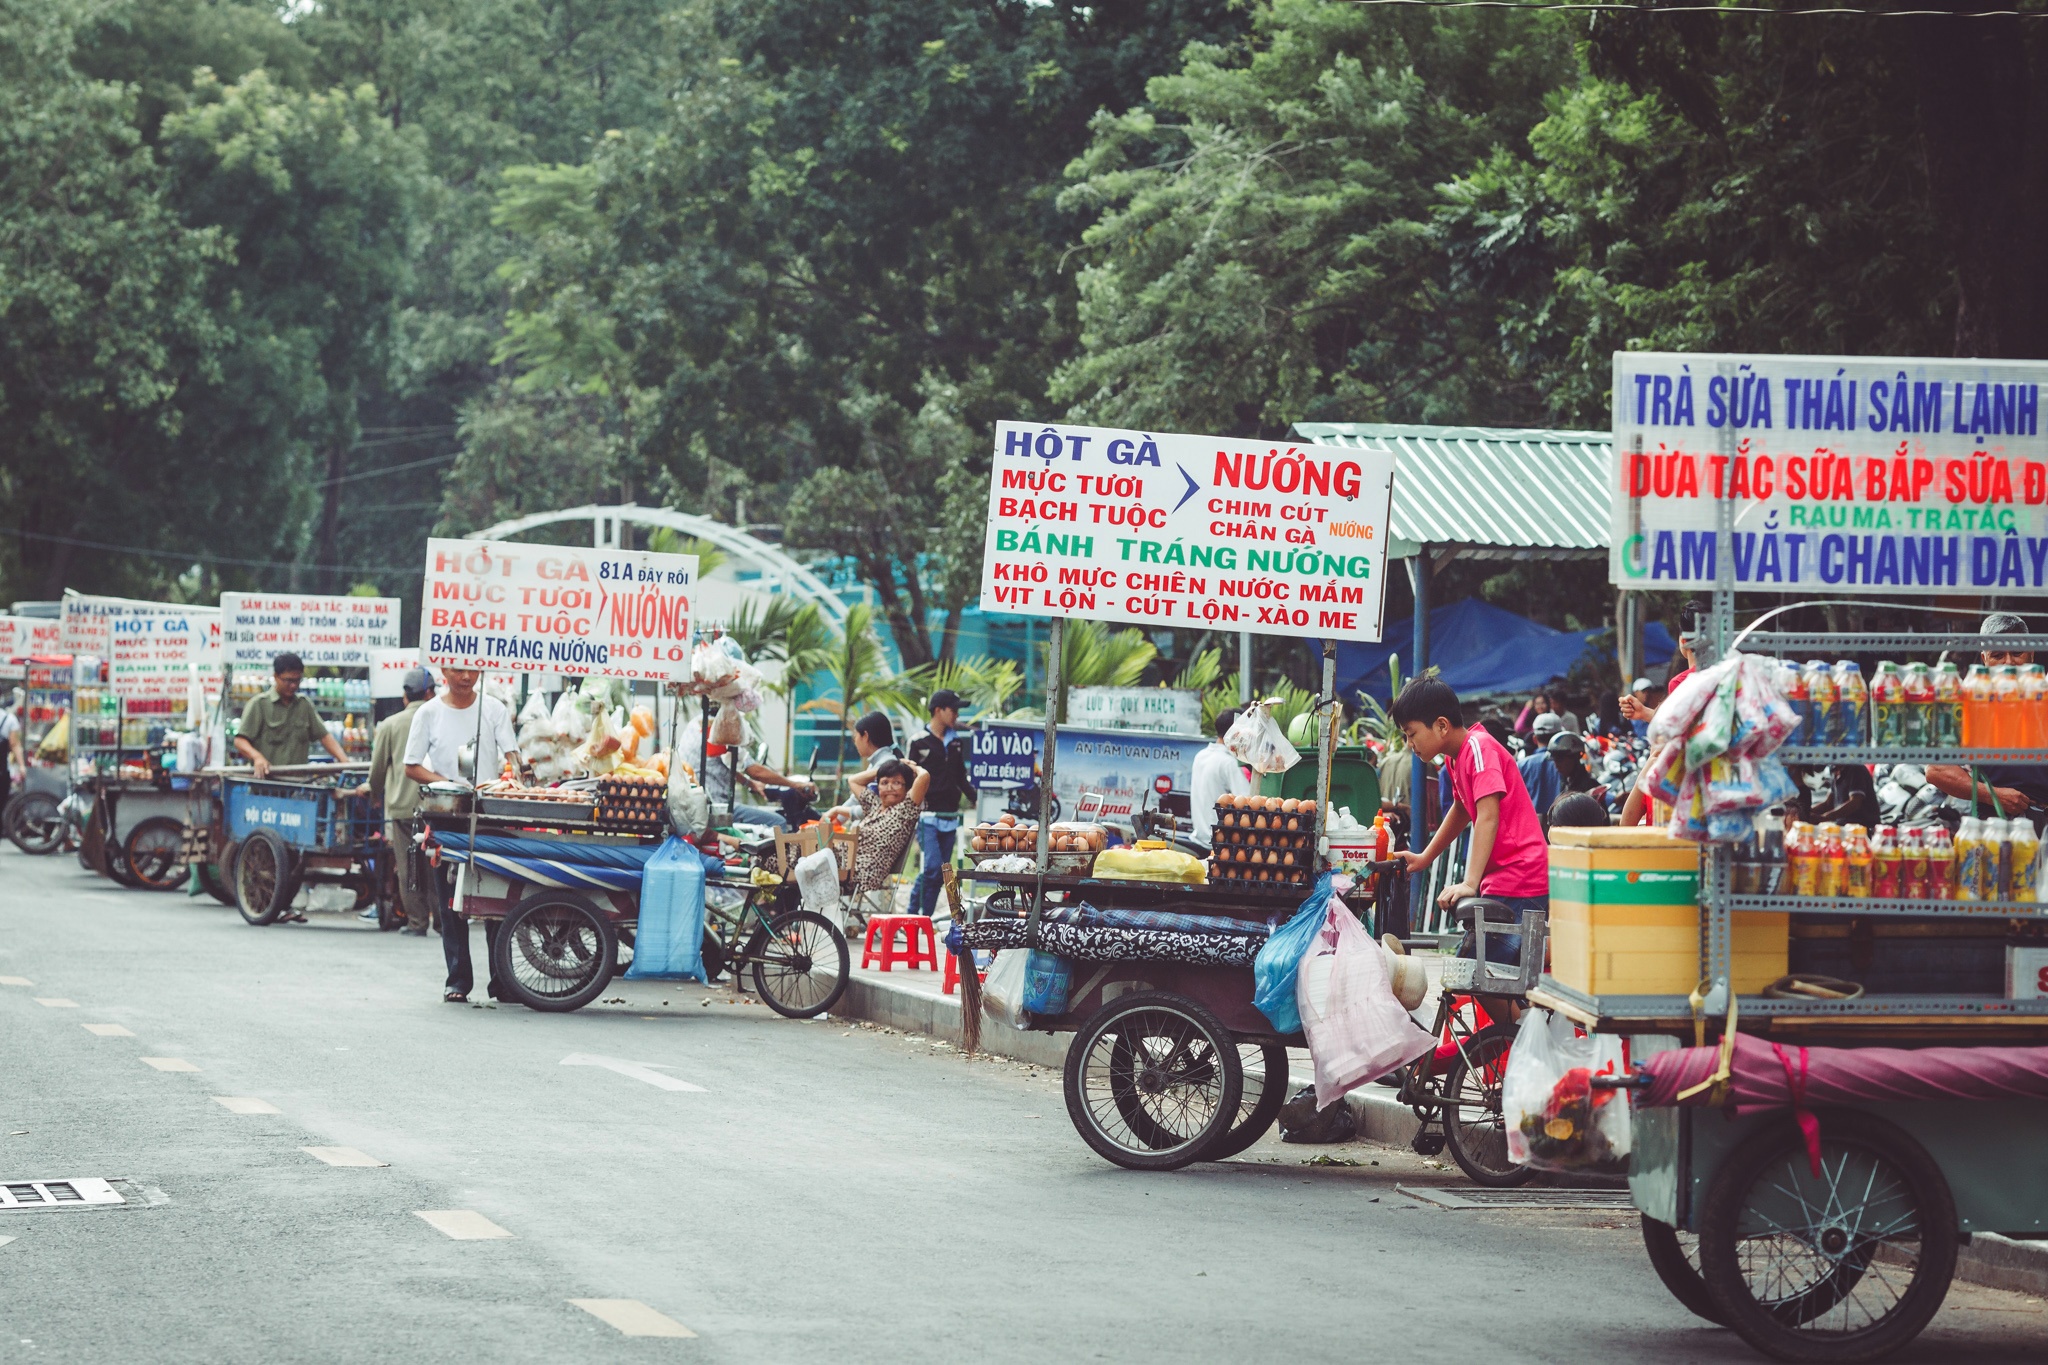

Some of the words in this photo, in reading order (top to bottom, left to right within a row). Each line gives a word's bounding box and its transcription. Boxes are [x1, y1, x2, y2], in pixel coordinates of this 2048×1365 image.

[1635, 364, 1695, 426] TRÀ
[1707, 364, 1772, 428] SỮA
[1784, 368, 1857, 430] THÁI
[1868, 371, 1943, 433] SÂM
[1953, 382, 2038, 444] LẠNH
[1005, 427, 1092, 466] HỘT
[1107, 434, 1161, 467] GÀ
[1001, 468, 1067, 496] MỰC
[1076, 473, 1143, 498] TƯƠI
[1213, 447, 1362, 499] NƯỚNG
[1630, 443, 1698, 498] DỪA
[1710, 438, 1774, 500] TẮC
[1786, 447, 1854, 501] SỮA
[1866, 441, 1934, 502] BẮP
[1945, 451, 2014, 504] SỮA
[999, 497, 1078, 524] BẠCH
[1089, 502, 1167, 533] TUỘC
[1207, 498, 1272, 518] CHIM
[1280, 501, 1329, 523] CÚT
[1209, 520, 1277, 541] CHÂN
[1285, 525, 1317, 545] GÀ
[1329, 520, 1373, 540] NƯỚNG
[996, 524, 1094, 558] BÁNH
[1116, 537, 1237, 570] TRÁNG
[1247, 545, 1371, 579] NƯỚNG
[1622, 530, 1717, 580] CAM
[1732, 510, 1806, 583] VẮT
[1819, 533, 1958, 586] CHANH
[1972, 527, 2048, 587] DÂY
[435, 546, 520, 580] HỘT
[536, 553, 590, 582] GÀ
[600, 561, 633, 581] 81A
[638, 567, 663, 583] ĐÂY
[667, 567, 688, 585] RỒI
[433, 581, 506, 606] MỰC
[517, 585, 592, 609] TƯƠI
[993, 562, 1048, 583] KHÔ
[1058, 567, 1117, 591] MỰC
[1126, 570, 1206, 595] CHIÊN
[1219, 577, 1290, 600] NƯỚC
[1299, 579, 1363, 604] MẮM
[351, 603, 371, 614] RAU
[610, 583, 689, 640] NƯỚNG
[993, 585, 1034, 609] VỊT
[1044, 588, 1096, 613] LỘN
[1125, 593, 1177, 616] CÚT
[1256, 604, 1309, 627] XÀO
[1319, 611, 1358, 630] ME
[115, 617, 154, 633] HỘT
[164, 618, 189, 632] GÀ
[431, 608, 506, 633] BẠCH
[517, 610, 591, 639] TUỘC
[256, 633, 278, 643] CAM
[309, 633, 342, 644] CHANH
[430, 630, 478, 655] BÁNH
[485, 635, 543, 660] TRÁNG
[549, 637, 608, 664] NƯỚNG
[609, 640, 643, 658] HỒ
[653, 645, 684, 662] LÔ
[428, 656, 457, 668] VỊT
[463, 657, 500, 669] LỘN
[511, 660, 547, 671] CÚT
[554, 663, 589, 675] LỘN
[602, 667, 638, 677] XÀO
[644, 671, 670, 680] ME
[973, 730, 998, 755] LỐI
[1001, 732, 1033, 755] VÀO
[1075, 742, 1092, 754] AN
[1095, 741, 1121, 756] TÂM
[988, 765, 998, 777] XE
[262, 807, 277, 824] CÂY
[280, 812, 301, 827] XANH
